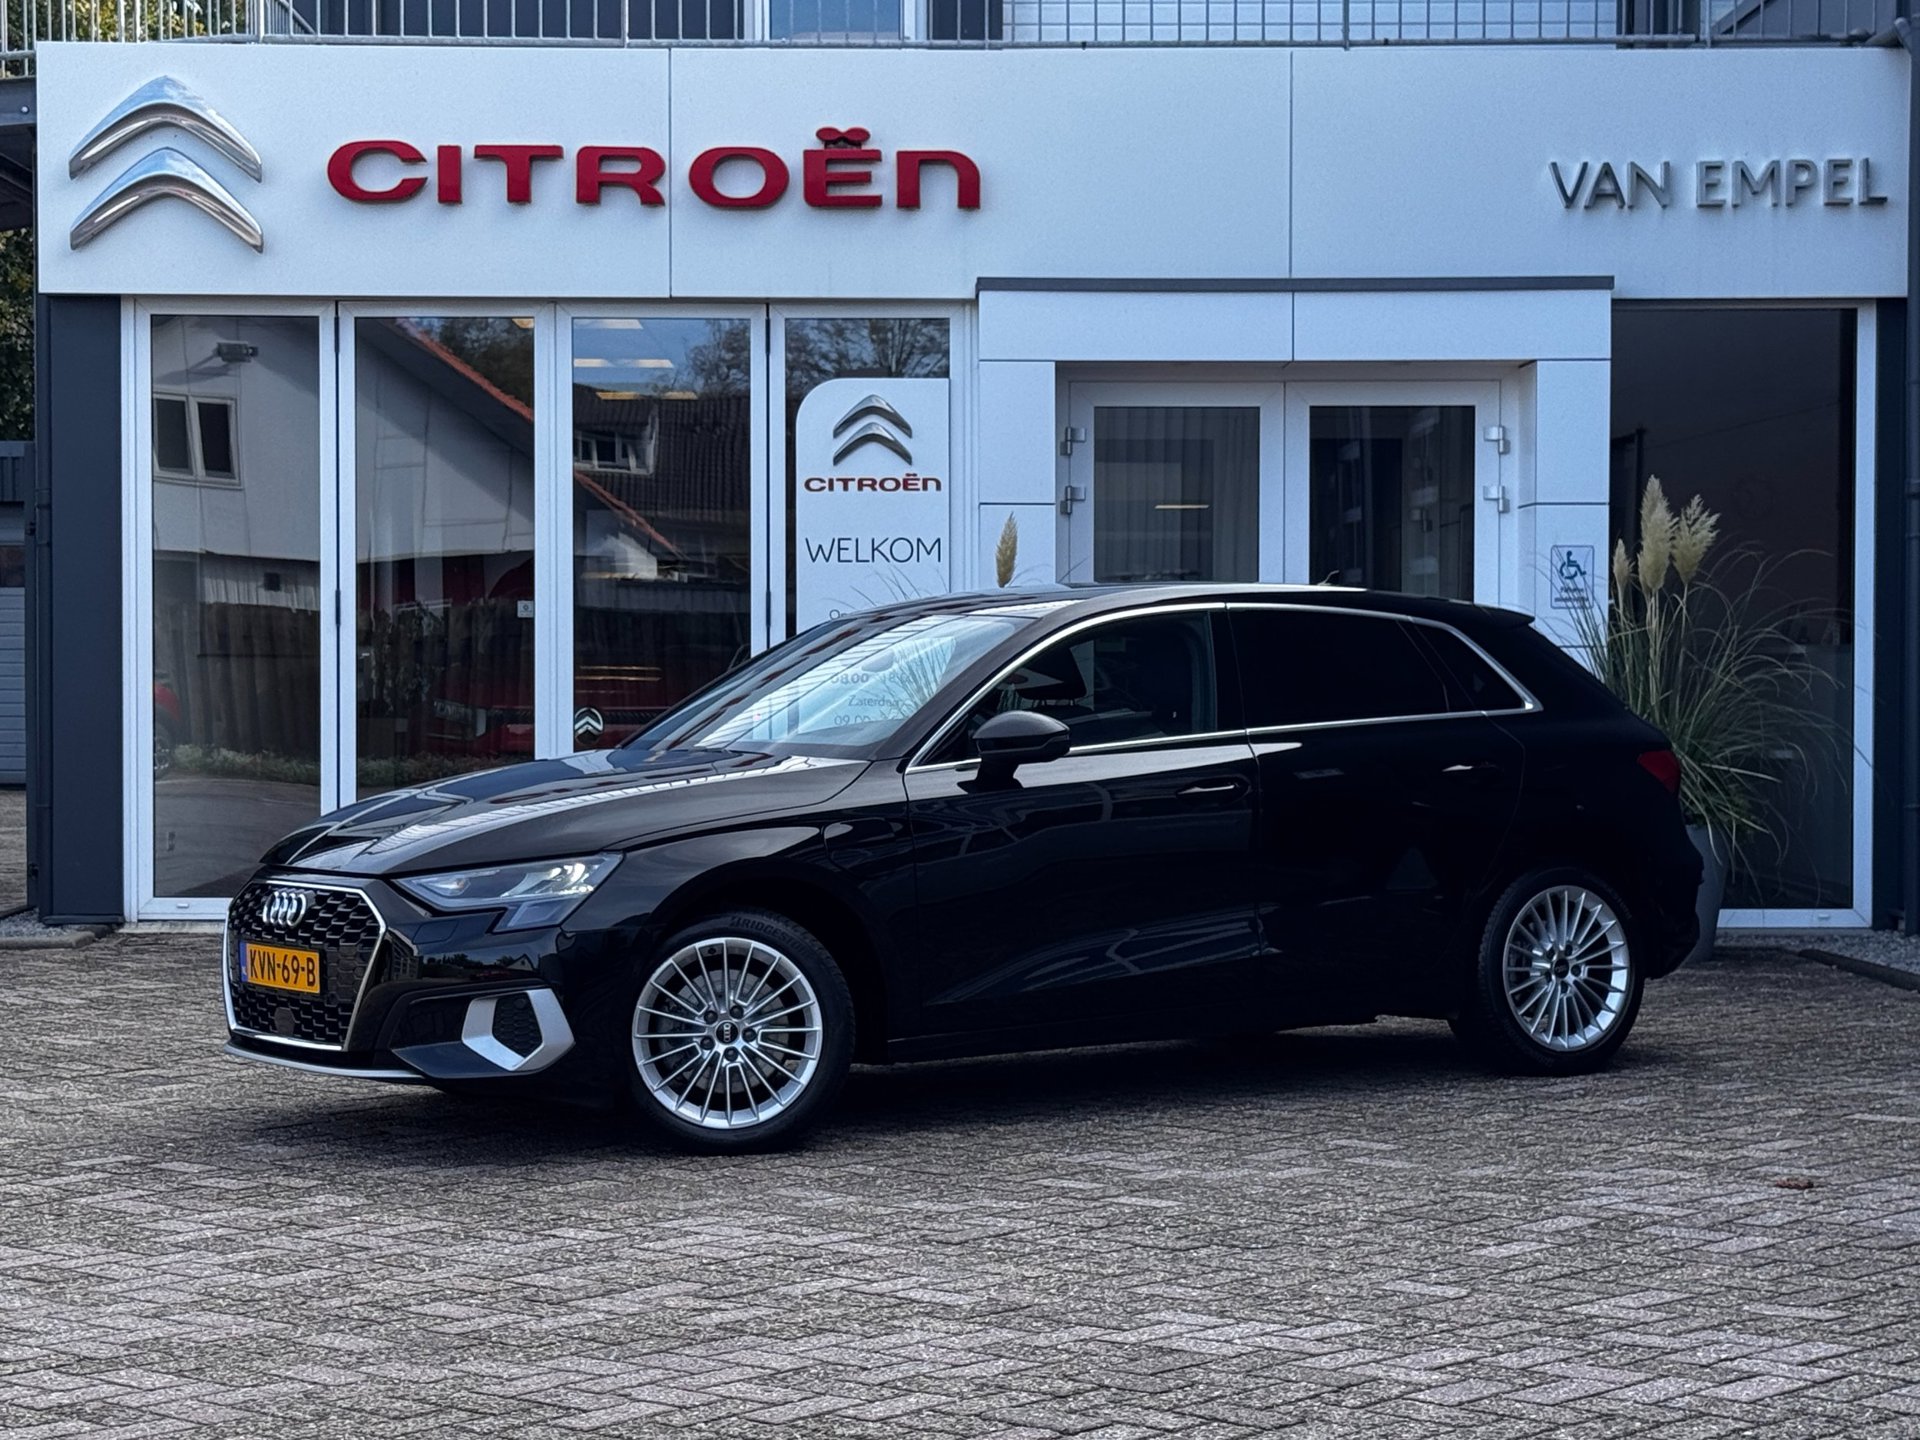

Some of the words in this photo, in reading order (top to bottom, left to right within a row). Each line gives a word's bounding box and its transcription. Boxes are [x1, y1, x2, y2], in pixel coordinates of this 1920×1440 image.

[1548, 159, 1671, 209] VAN
[1695, 157, 1889, 208] EMPEL
[805, 537, 942, 563] WELKOM
[250, 948, 316, 987] KVN-69-B
